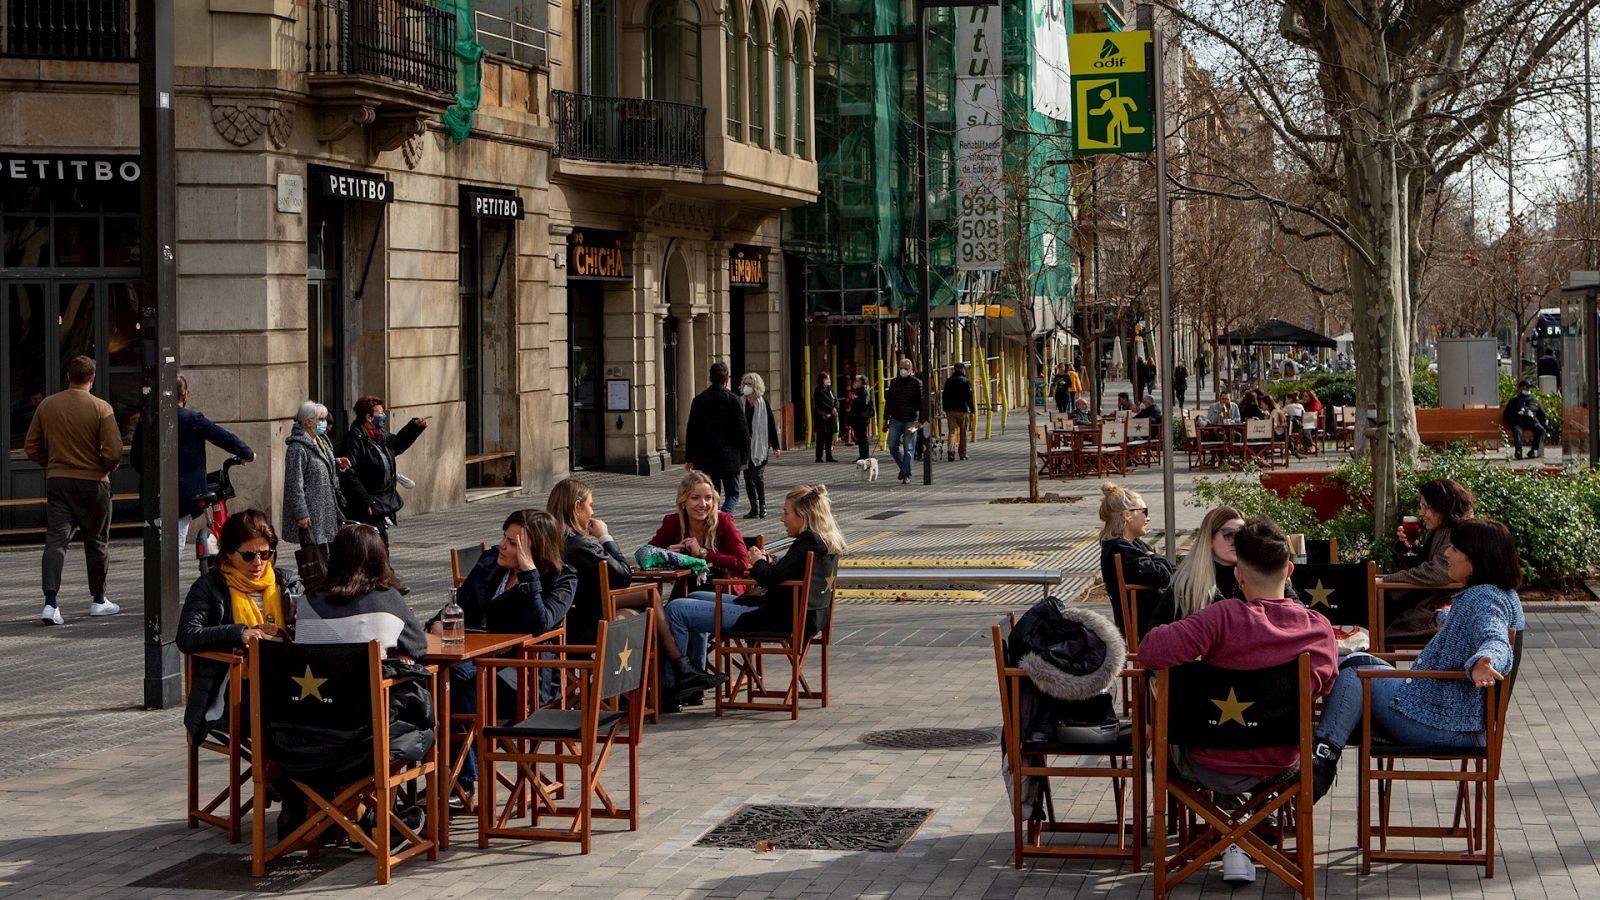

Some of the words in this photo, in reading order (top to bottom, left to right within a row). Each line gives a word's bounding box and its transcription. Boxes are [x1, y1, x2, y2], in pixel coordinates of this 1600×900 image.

[1093, 57, 1127, 69] adif
[0, 159, 141, 182] ETITBO
[329, 174, 386, 201] PETITBO
[476, 197, 518, 217] PETITBO
[962, 196, 999, 216] 934
[962, 219, 999, 239] 508
[573, 245, 625, 276] CHICHA
[962, 242, 999, 262] 933
